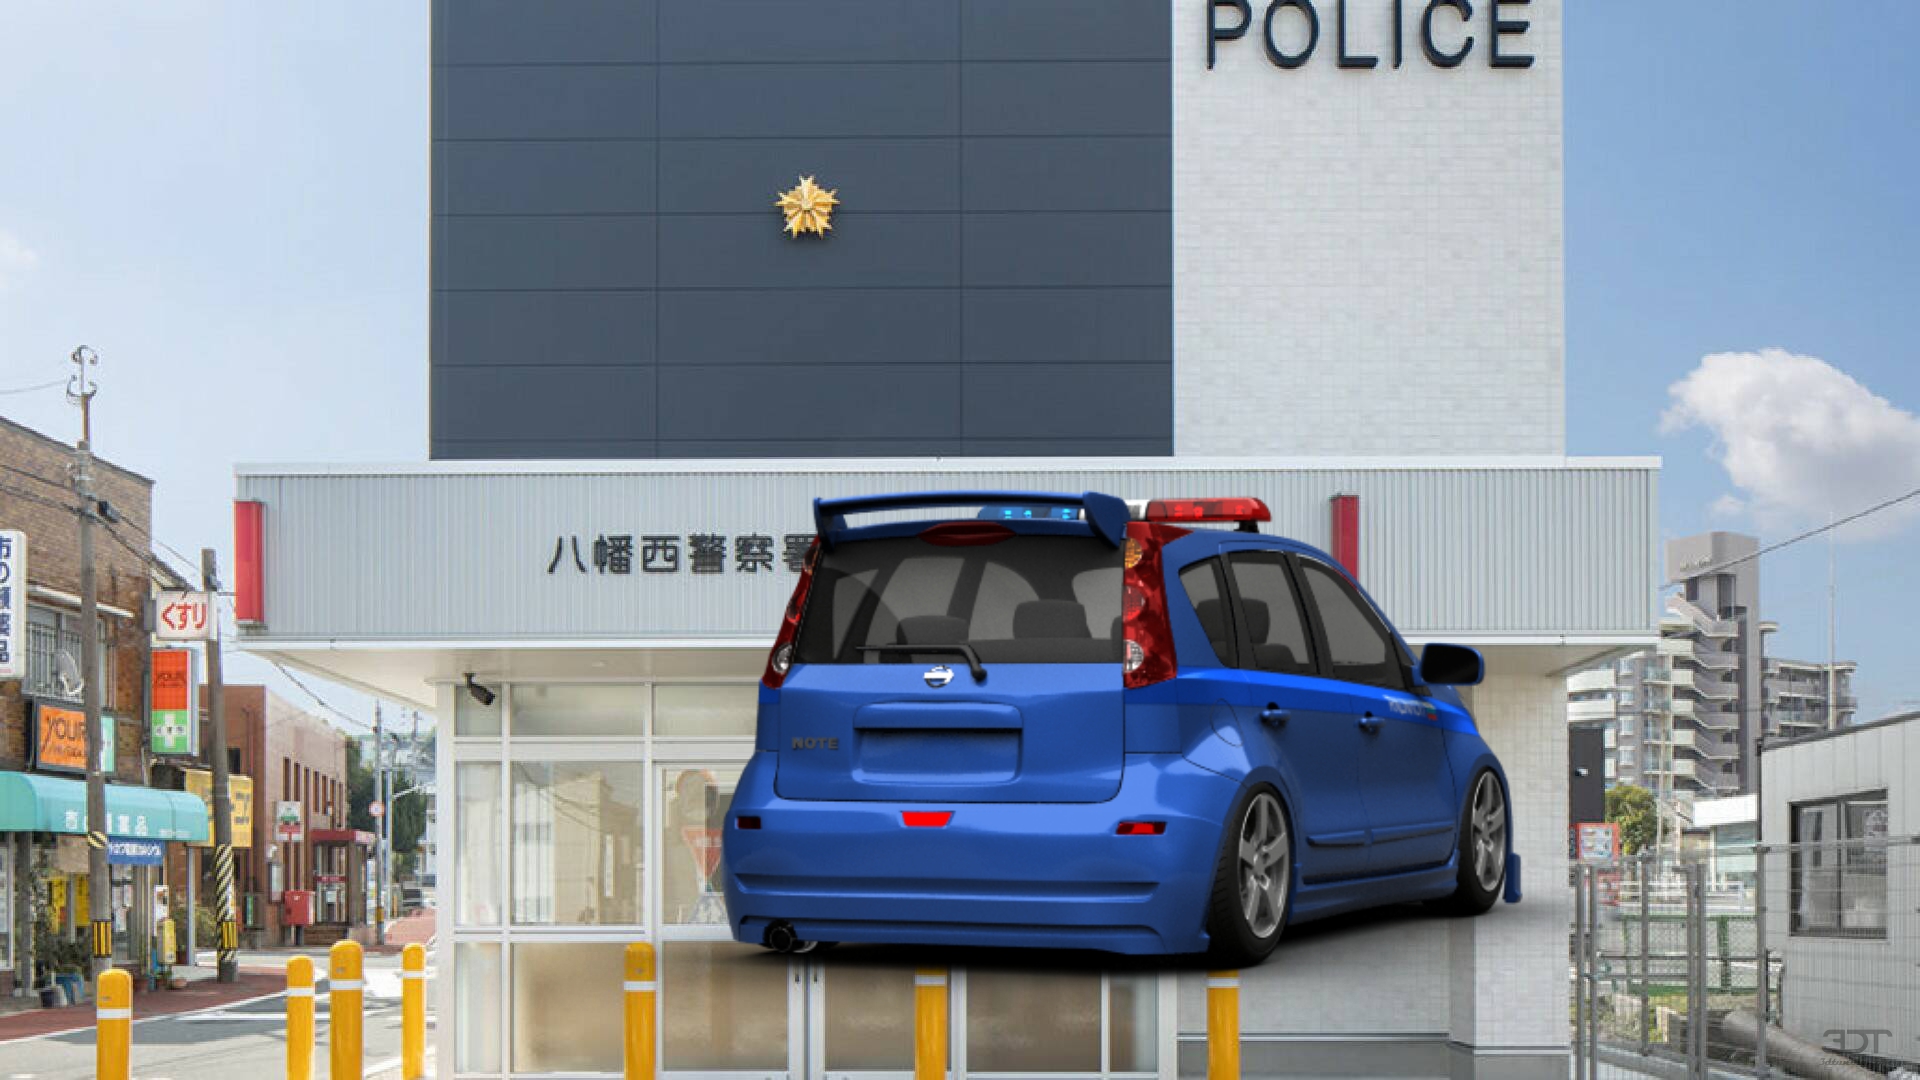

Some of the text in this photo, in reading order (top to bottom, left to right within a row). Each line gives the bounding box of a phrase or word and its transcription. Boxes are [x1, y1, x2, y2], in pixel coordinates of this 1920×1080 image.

[1207, 0, 1535, 70] POLICE
[161, 602, 207, 630] くすり
[791, 737, 839, 750] NOTE
